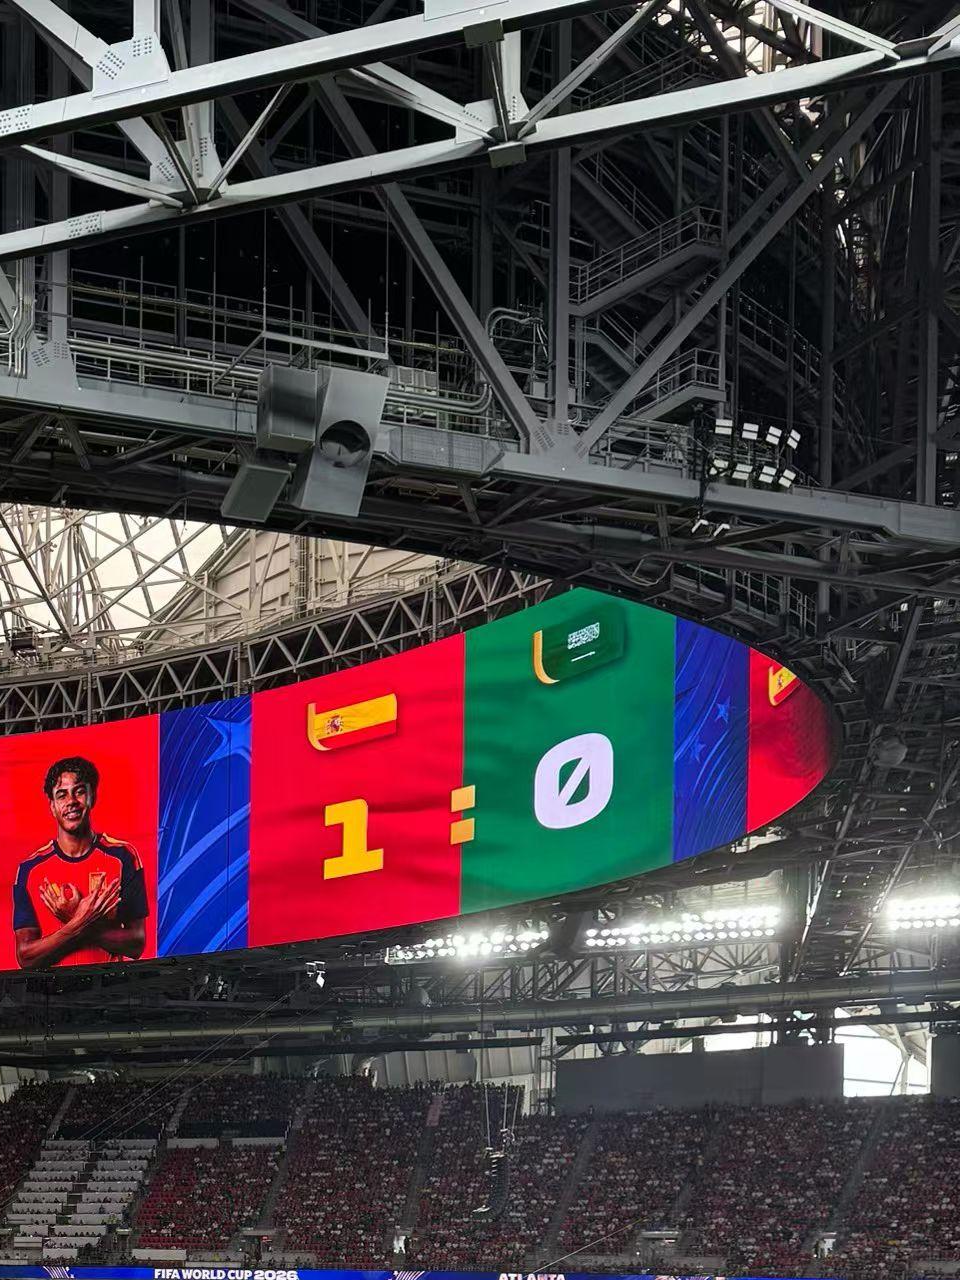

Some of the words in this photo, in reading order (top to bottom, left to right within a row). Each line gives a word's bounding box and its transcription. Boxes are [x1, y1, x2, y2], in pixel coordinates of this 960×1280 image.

[323, 799, 384, 880] 1
[534, 732, 614, 829] 0
[154, 1268, 181, 1280] FIFA
[181, 1268, 227, 1280] WORLD
[227, 1269, 253, 1280] CUP
[253, 1269, 299, 1280] 2026
